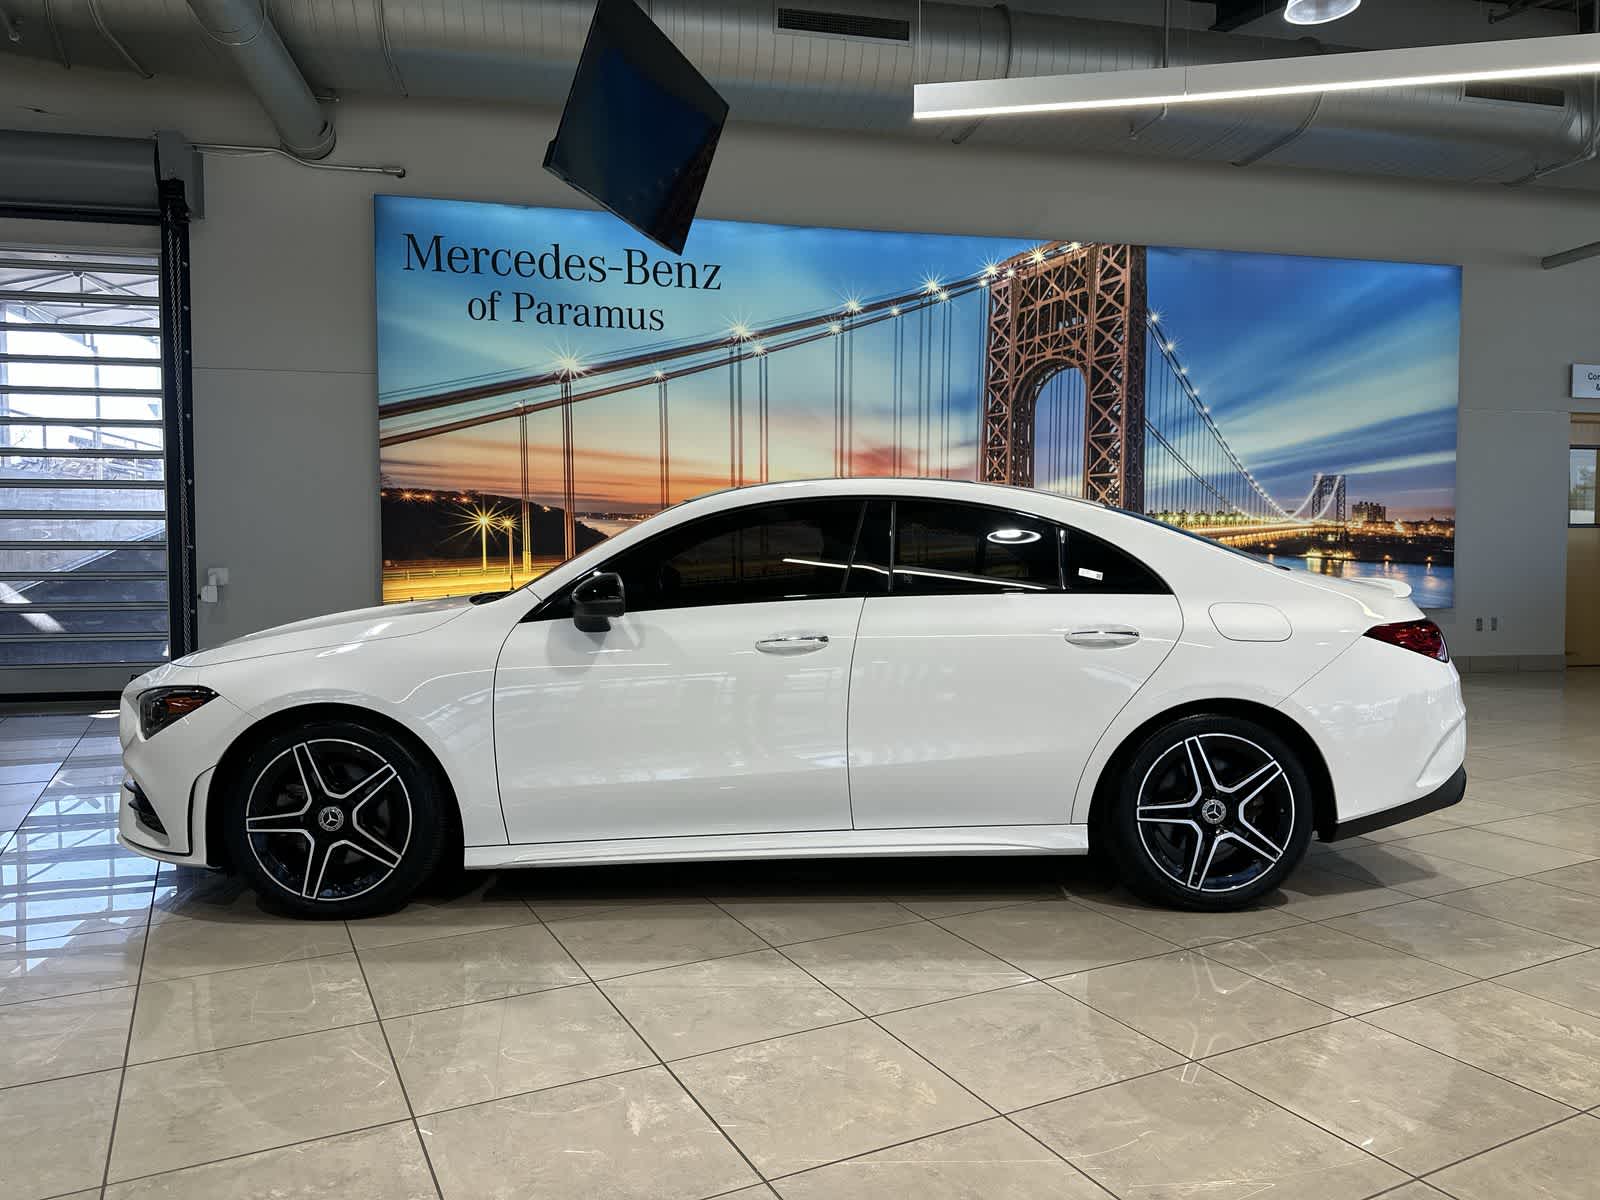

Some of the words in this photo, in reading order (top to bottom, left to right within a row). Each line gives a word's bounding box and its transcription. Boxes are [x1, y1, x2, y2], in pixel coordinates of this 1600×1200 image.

[401, 232, 722, 290] Mercedes-Benz
[468, 290, 503, 321] of
[511, 291, 665, 331] Paramus
